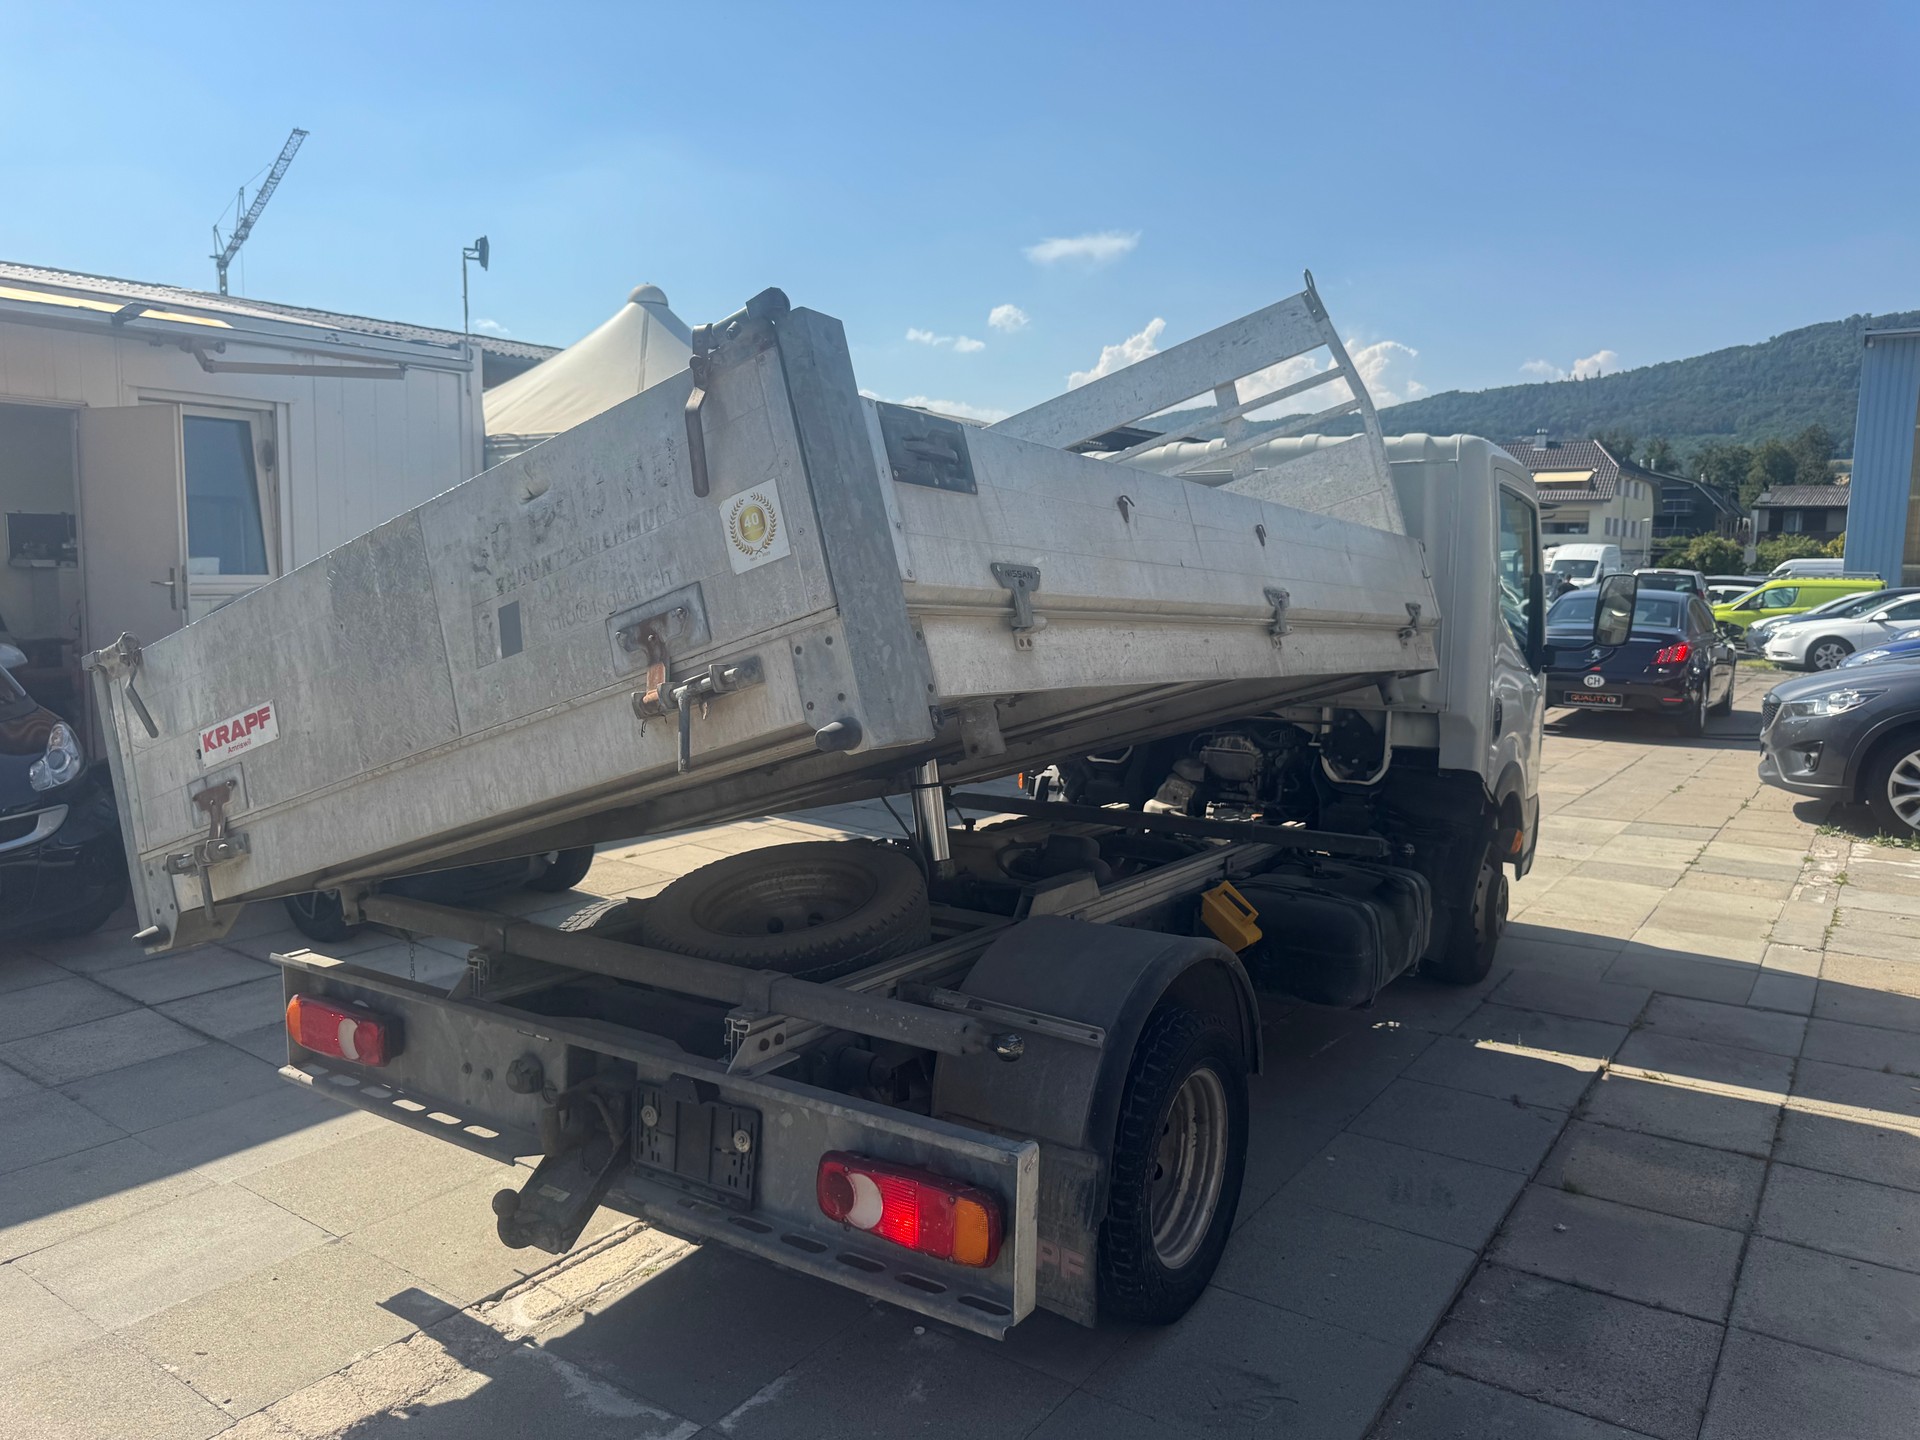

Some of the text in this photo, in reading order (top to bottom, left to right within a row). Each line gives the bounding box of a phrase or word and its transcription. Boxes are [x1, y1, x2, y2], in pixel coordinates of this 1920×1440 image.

[744, 512, 759, 528] 40
[1005, 570, 1032, 579] NISSAN
[1587, 676, 1601, 686] CH
[203, 707, 271, 753] KRAPF
